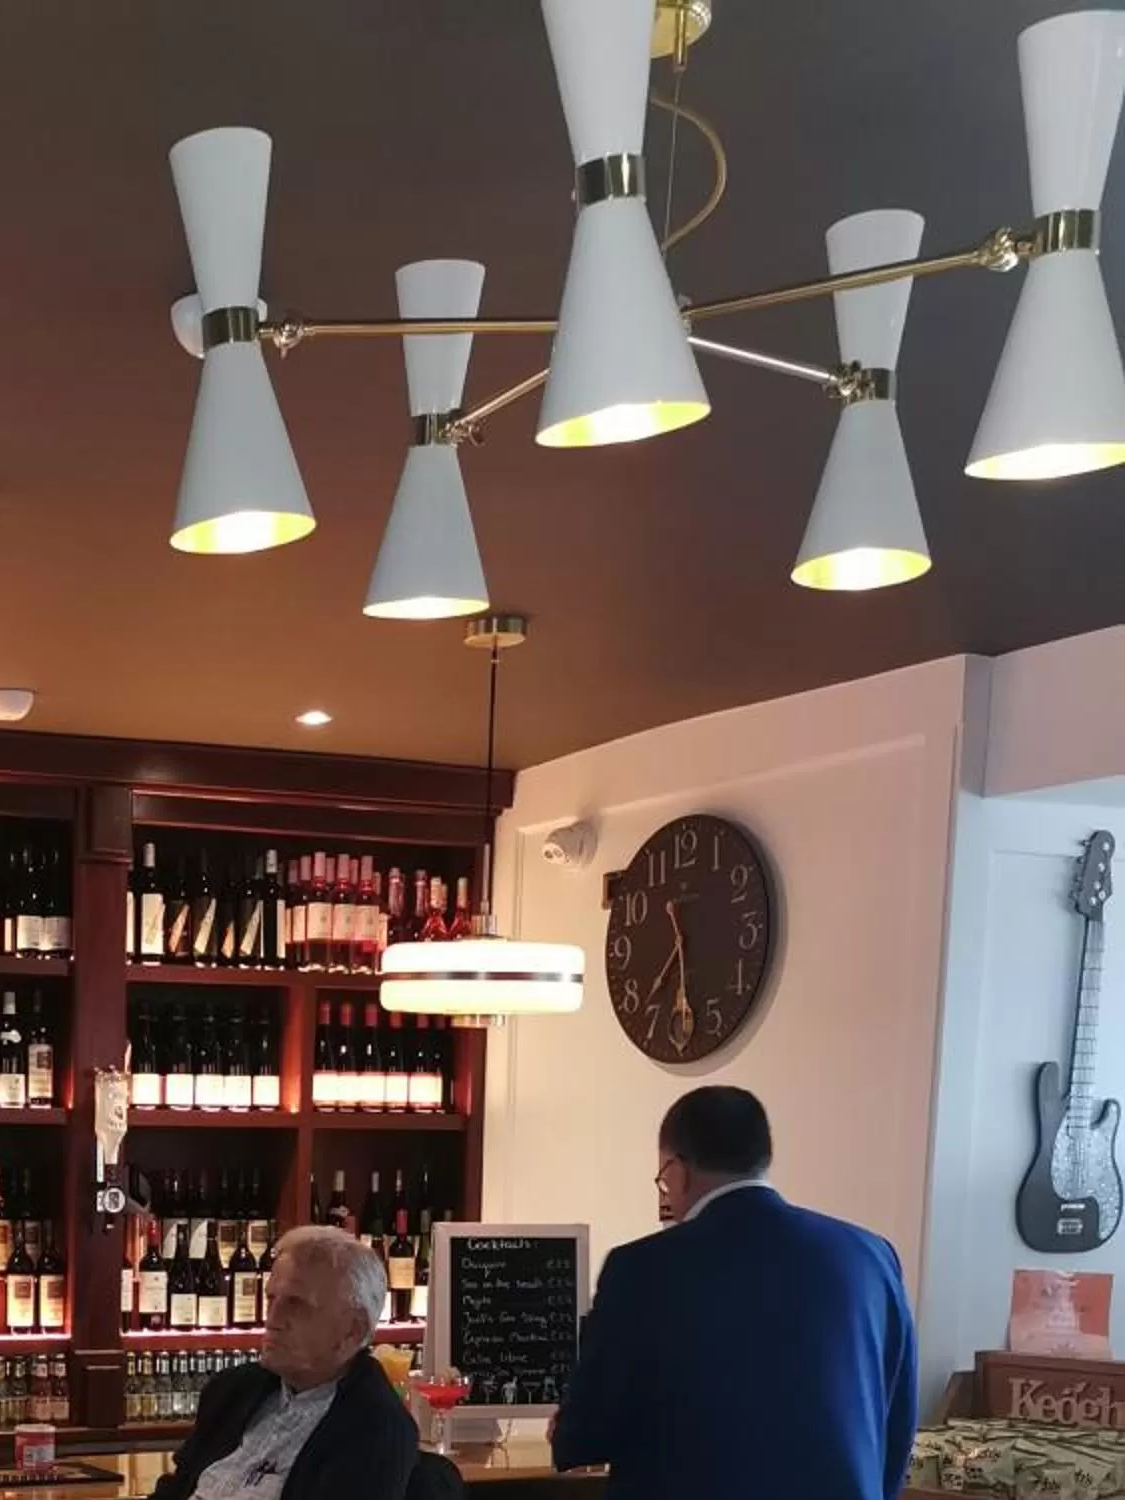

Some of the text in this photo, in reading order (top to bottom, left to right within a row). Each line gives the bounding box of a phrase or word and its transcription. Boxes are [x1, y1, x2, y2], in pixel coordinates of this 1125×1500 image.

[674, 829, 698, 869] 12
[711, 830, 724, 872] 1
[646, 850, 666, 888] 11
[730, 864, 751, 903] 2
[621, 891, 648, 927] 10
[739, 911, 761, 949] 3
[613, 936, 632, 970] 9
[620, 978, 639, 1014] 8
[728, 959, 751, 996] 4
[645, 1003, 660, 1040] 7
[706, 998, 724, 1037] 5
